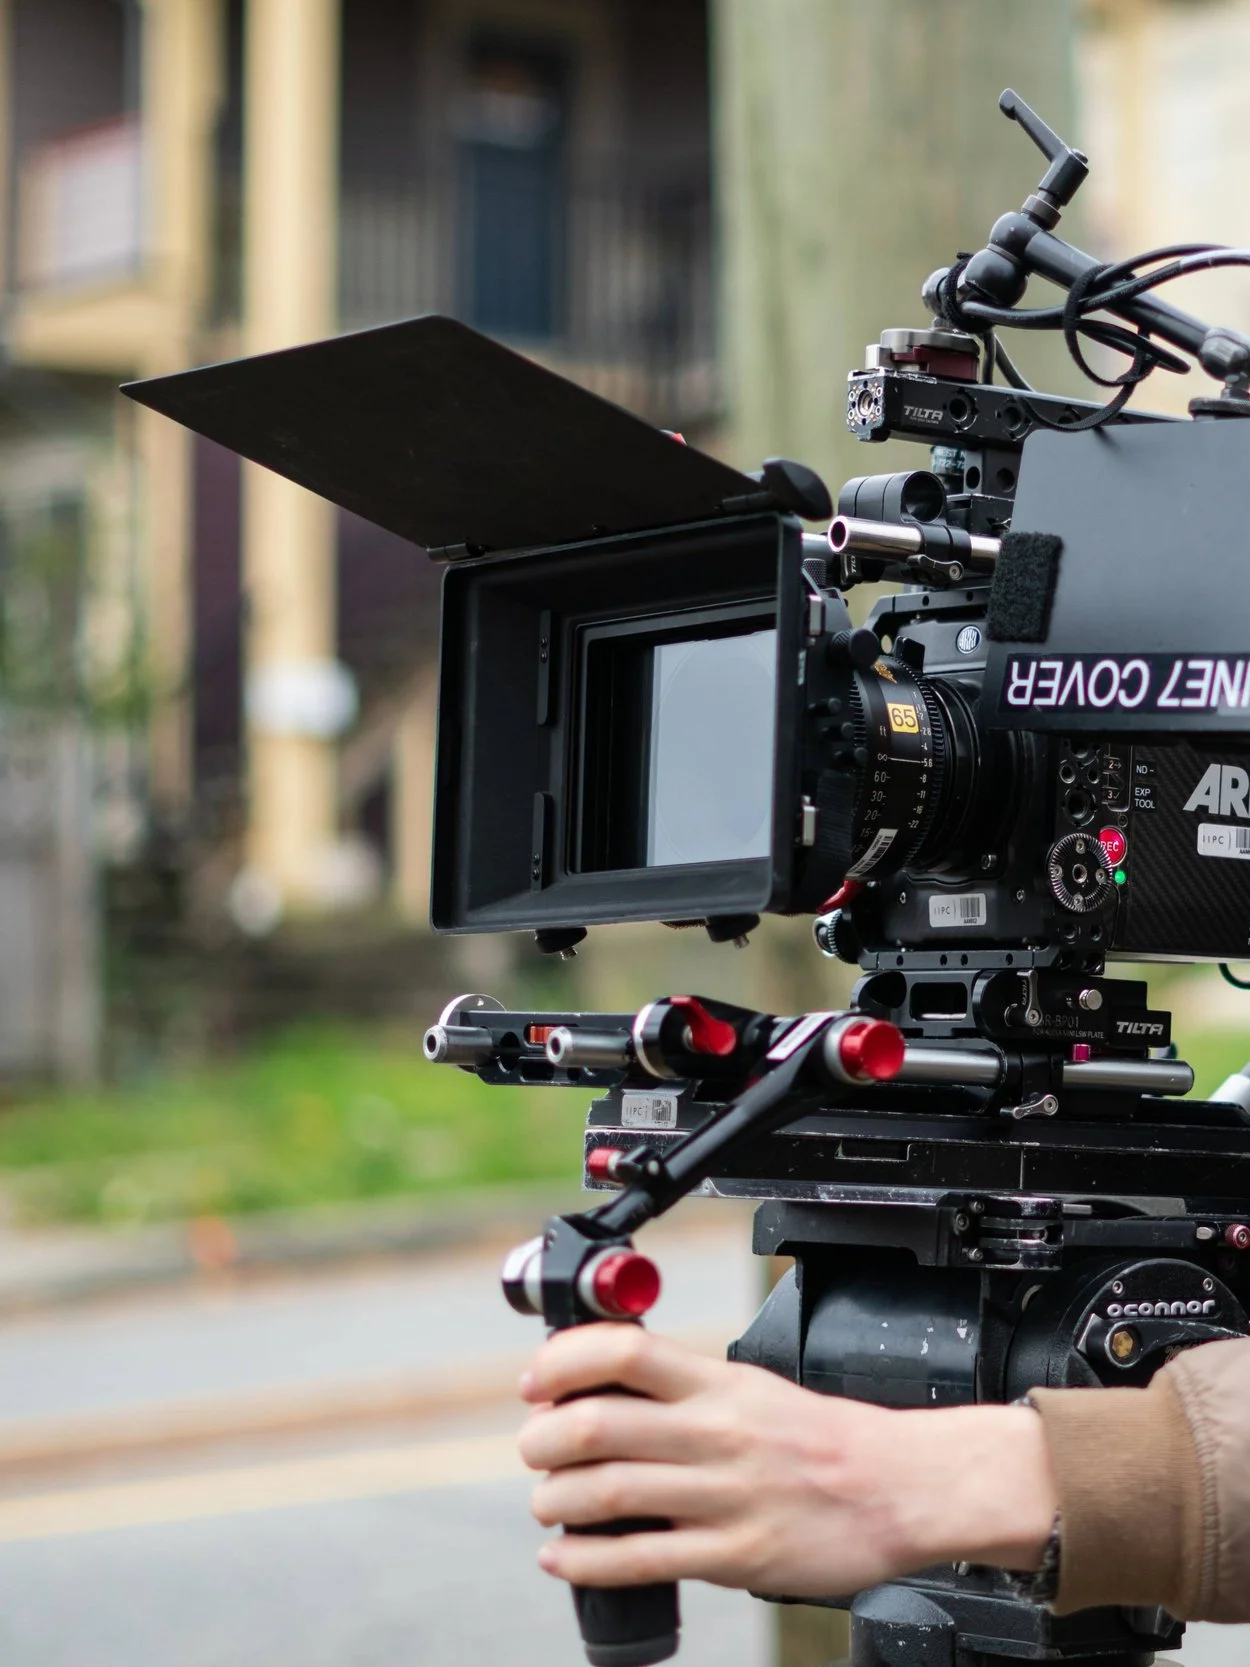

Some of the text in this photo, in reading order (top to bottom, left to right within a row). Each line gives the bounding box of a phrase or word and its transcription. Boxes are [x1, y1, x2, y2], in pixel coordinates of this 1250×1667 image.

[904, 405, 944, 421] TILTA
[958, 628, 979, 651] ARRI
[1007, 659, 1150, 707] COVER
[891, 708, 916, 728] 65
[880, 726, 887, 737] ft
[1136, 765, 1148, 774] ND
[874, 771, 887, 782] 60
[870, 790, 883, 802] 30
[1134, 787, 1151, 796] EXP
[1134, 798, 1155, 809] TOOL
[864, 809, 878, 821] 20
[1100, 841, 1119, 852] REC
[1115, 1021, 1164, 1036] TILTA
[1087, 1031, 1104, 1039] PLATE
[1107, 1300, 1215, 1318] oconnor
